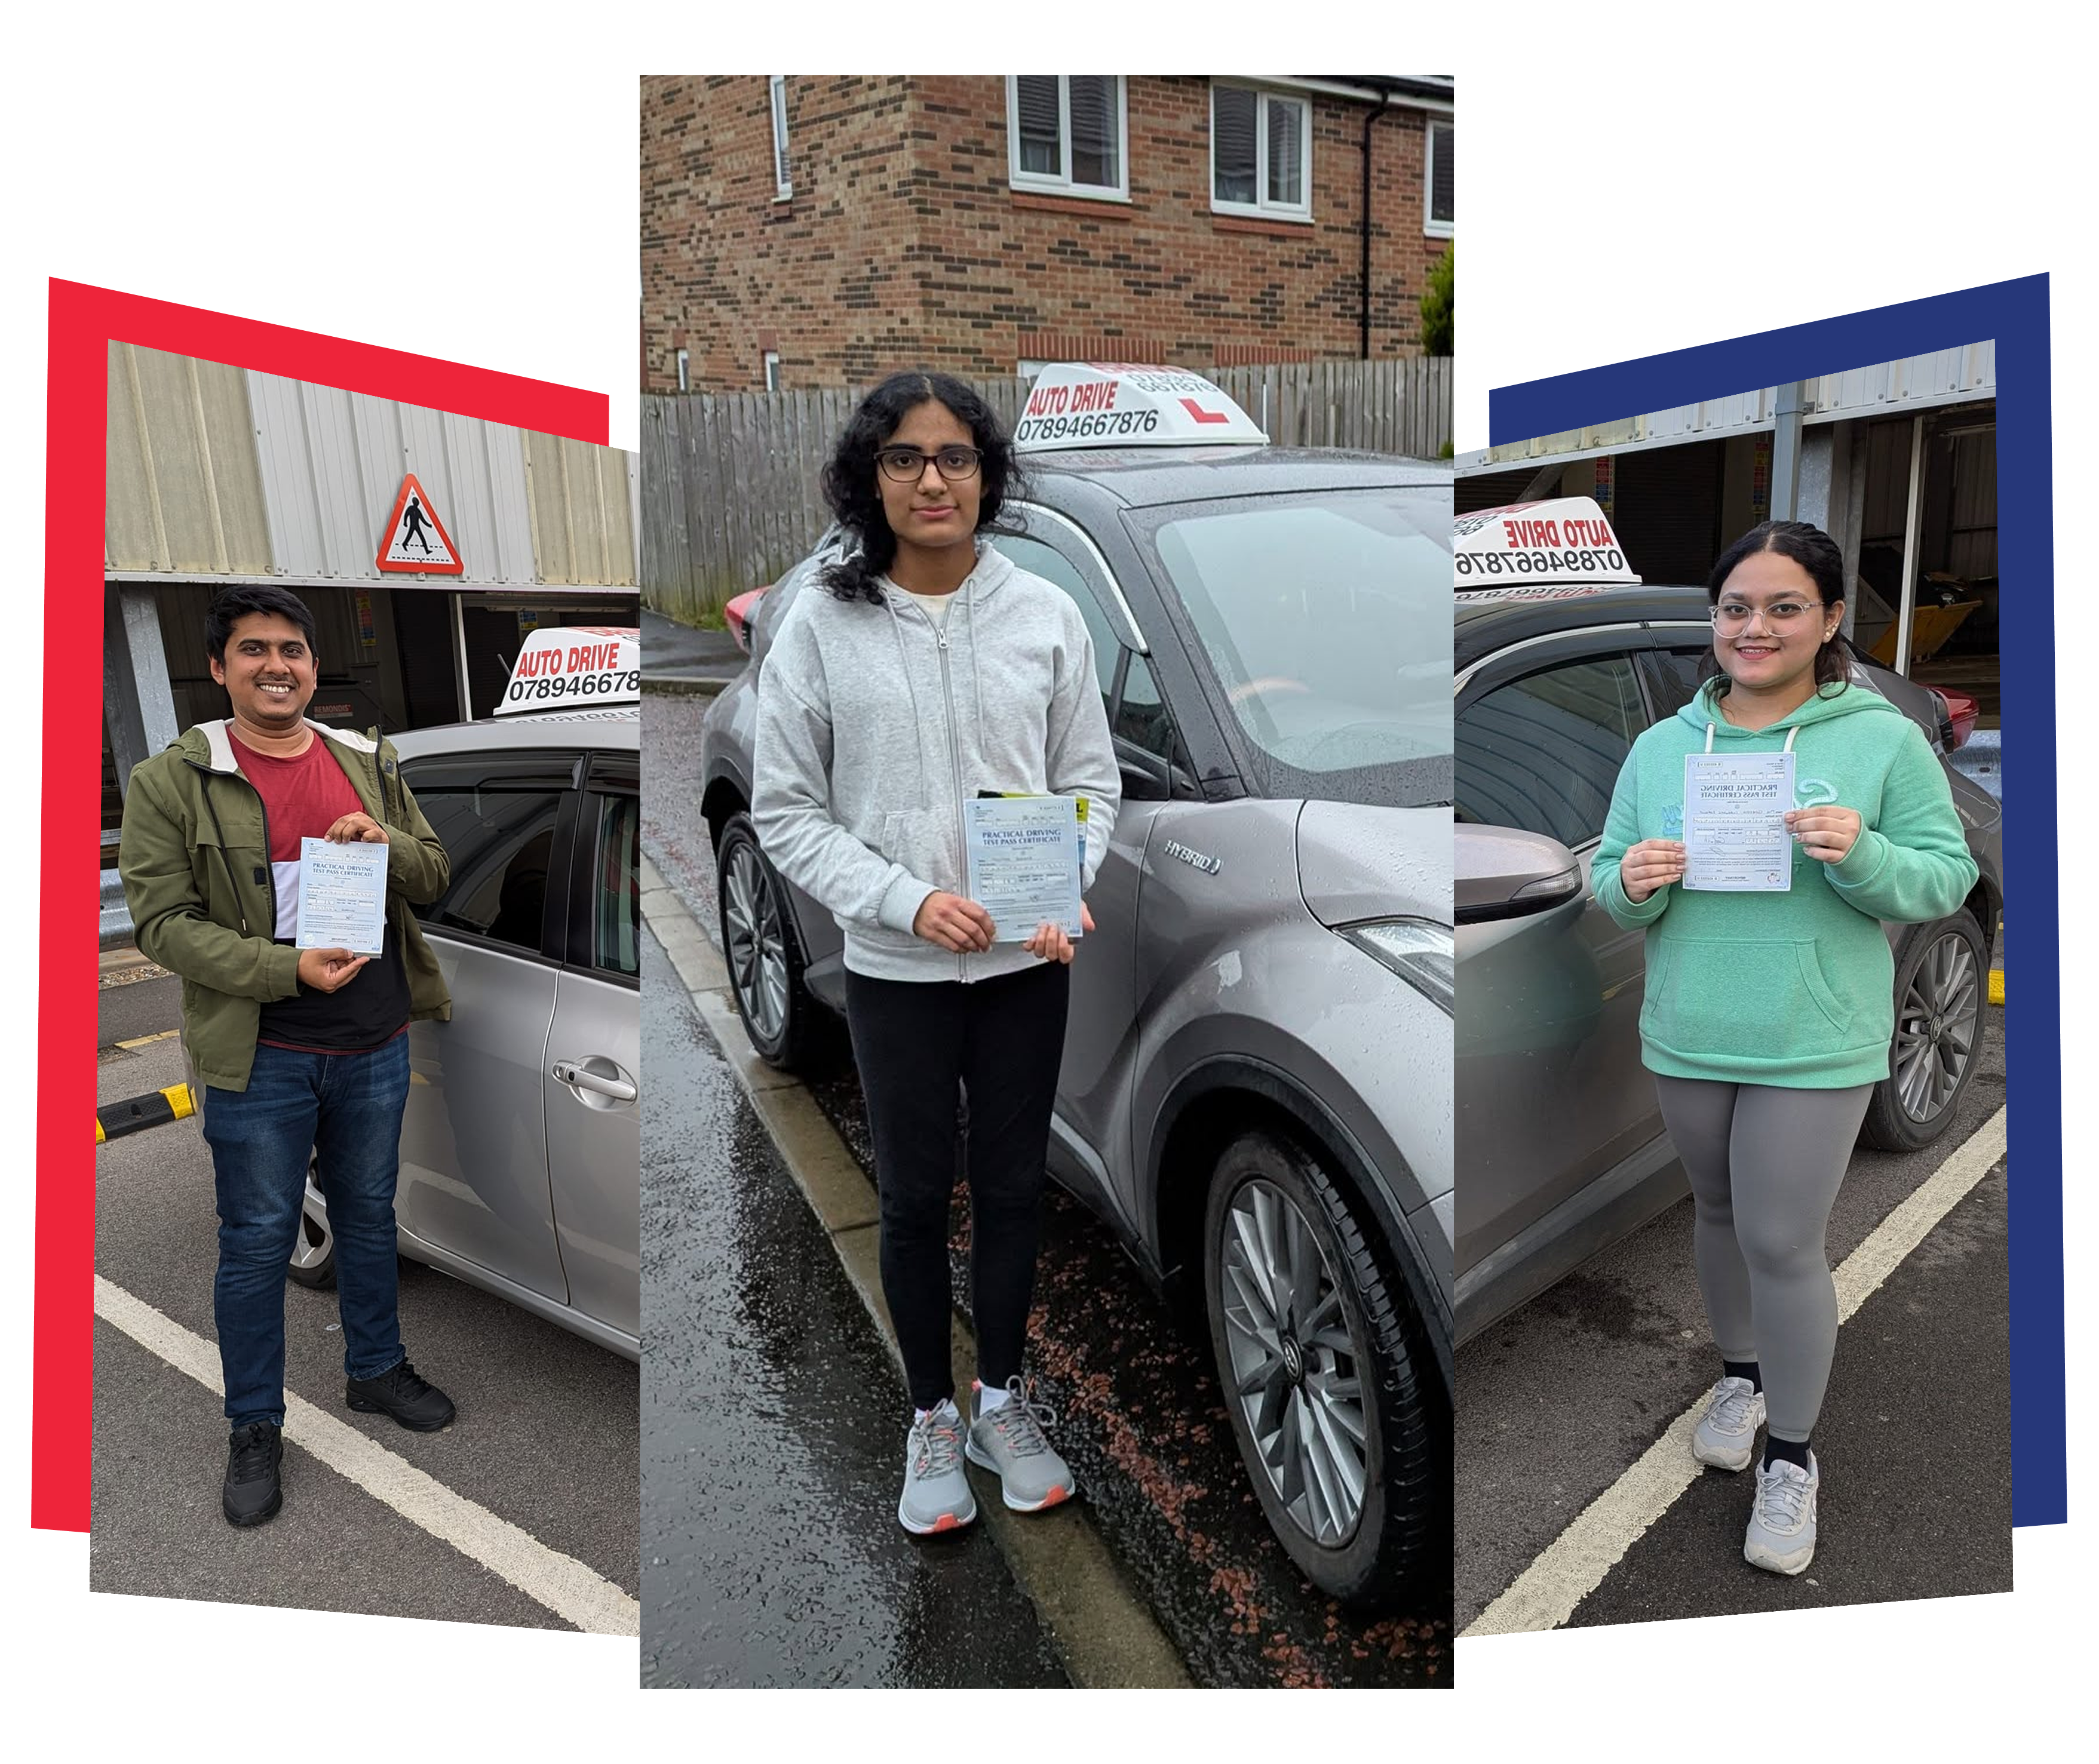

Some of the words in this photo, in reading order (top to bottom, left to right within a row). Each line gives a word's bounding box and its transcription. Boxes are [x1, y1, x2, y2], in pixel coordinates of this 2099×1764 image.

[1027, 385, 1068, 416] AUTO
[1070, 381, 1119, 413] DRIVE
[1017, 409, 1159, 442] 07894667876
[516, 649, 563, 678] AUTO
[567, 643, 620, 673] DRIVE
[510, 670, 640, 701] 078946678
[1164, 839, 1211, 870] HYBRID
